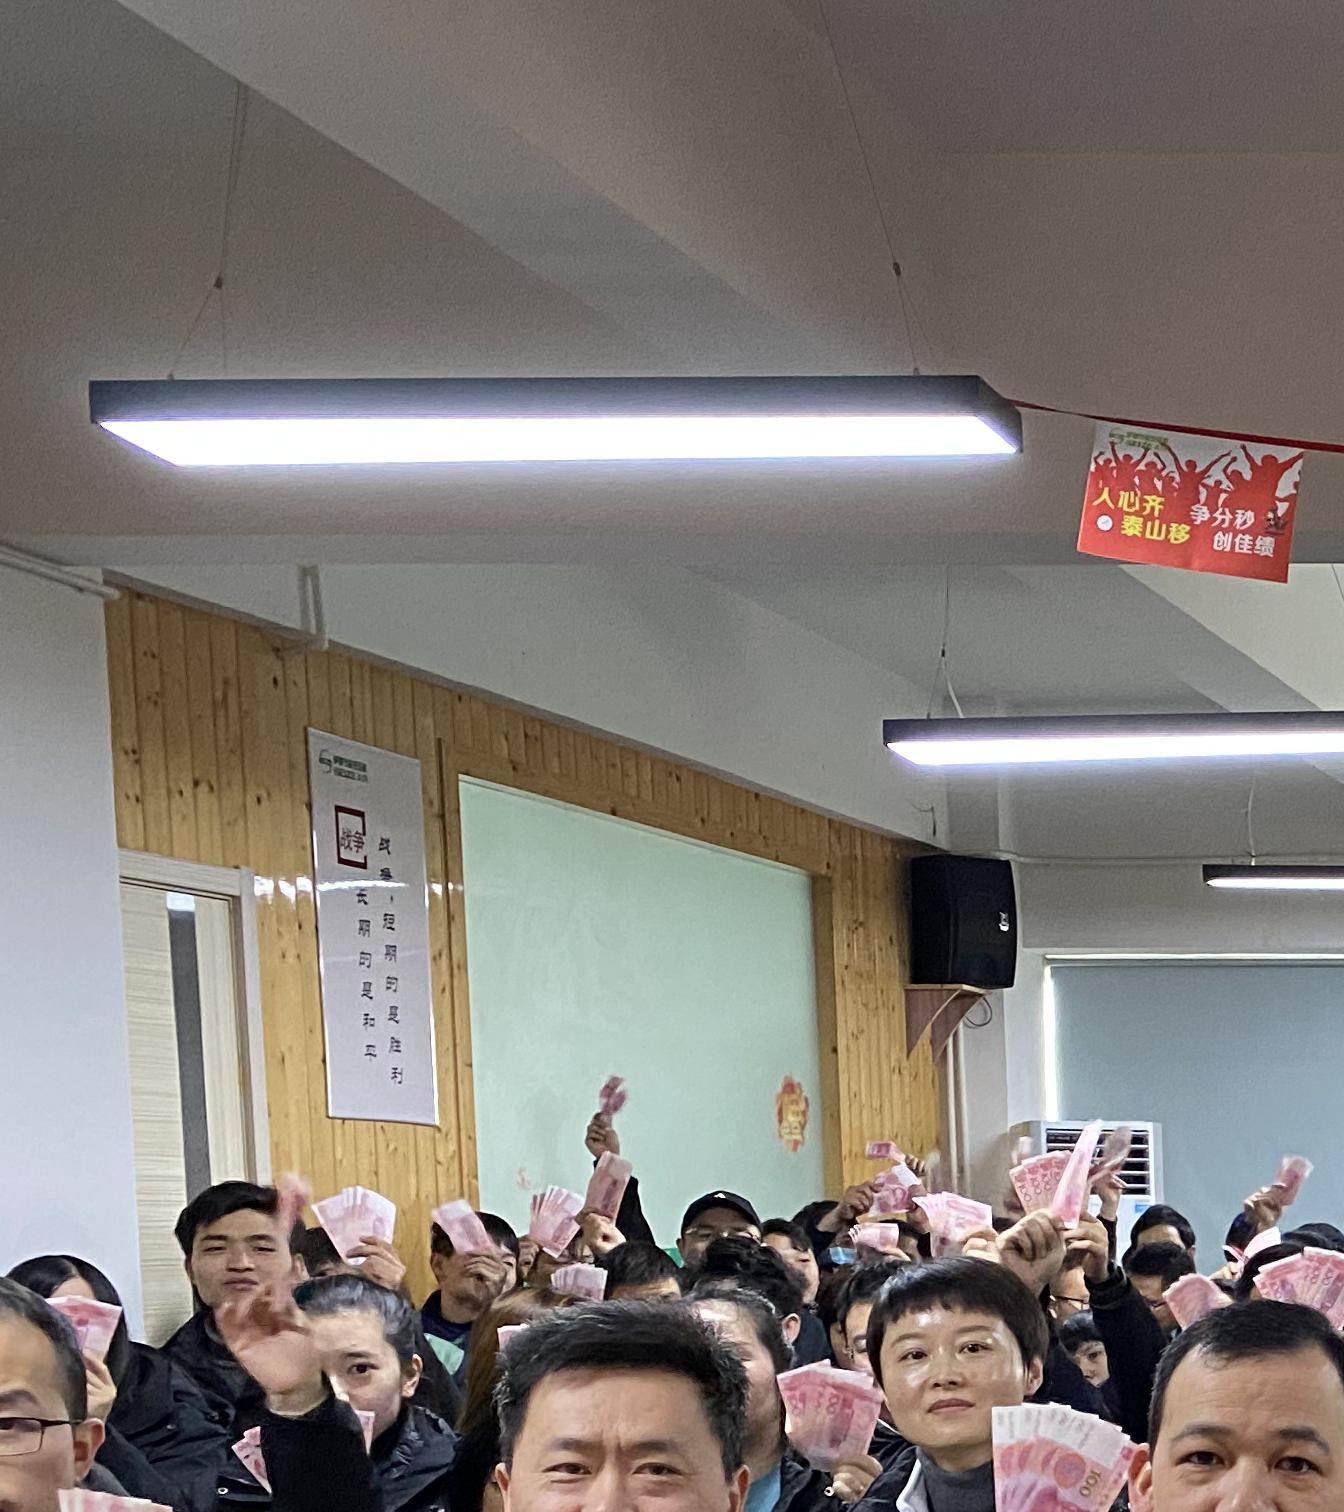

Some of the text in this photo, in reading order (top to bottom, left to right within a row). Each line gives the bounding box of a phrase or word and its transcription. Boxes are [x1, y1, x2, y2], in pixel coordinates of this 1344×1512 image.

[1092, 487, 1165, 518] 人心齐
[1190, 503, 1256, 530] 争分秒
[1121, 515, 1191, 545] 泰山移
[1212, 531, 1276, 557] 创佳绩
[1079, 1470, 1100, 1498] 100
